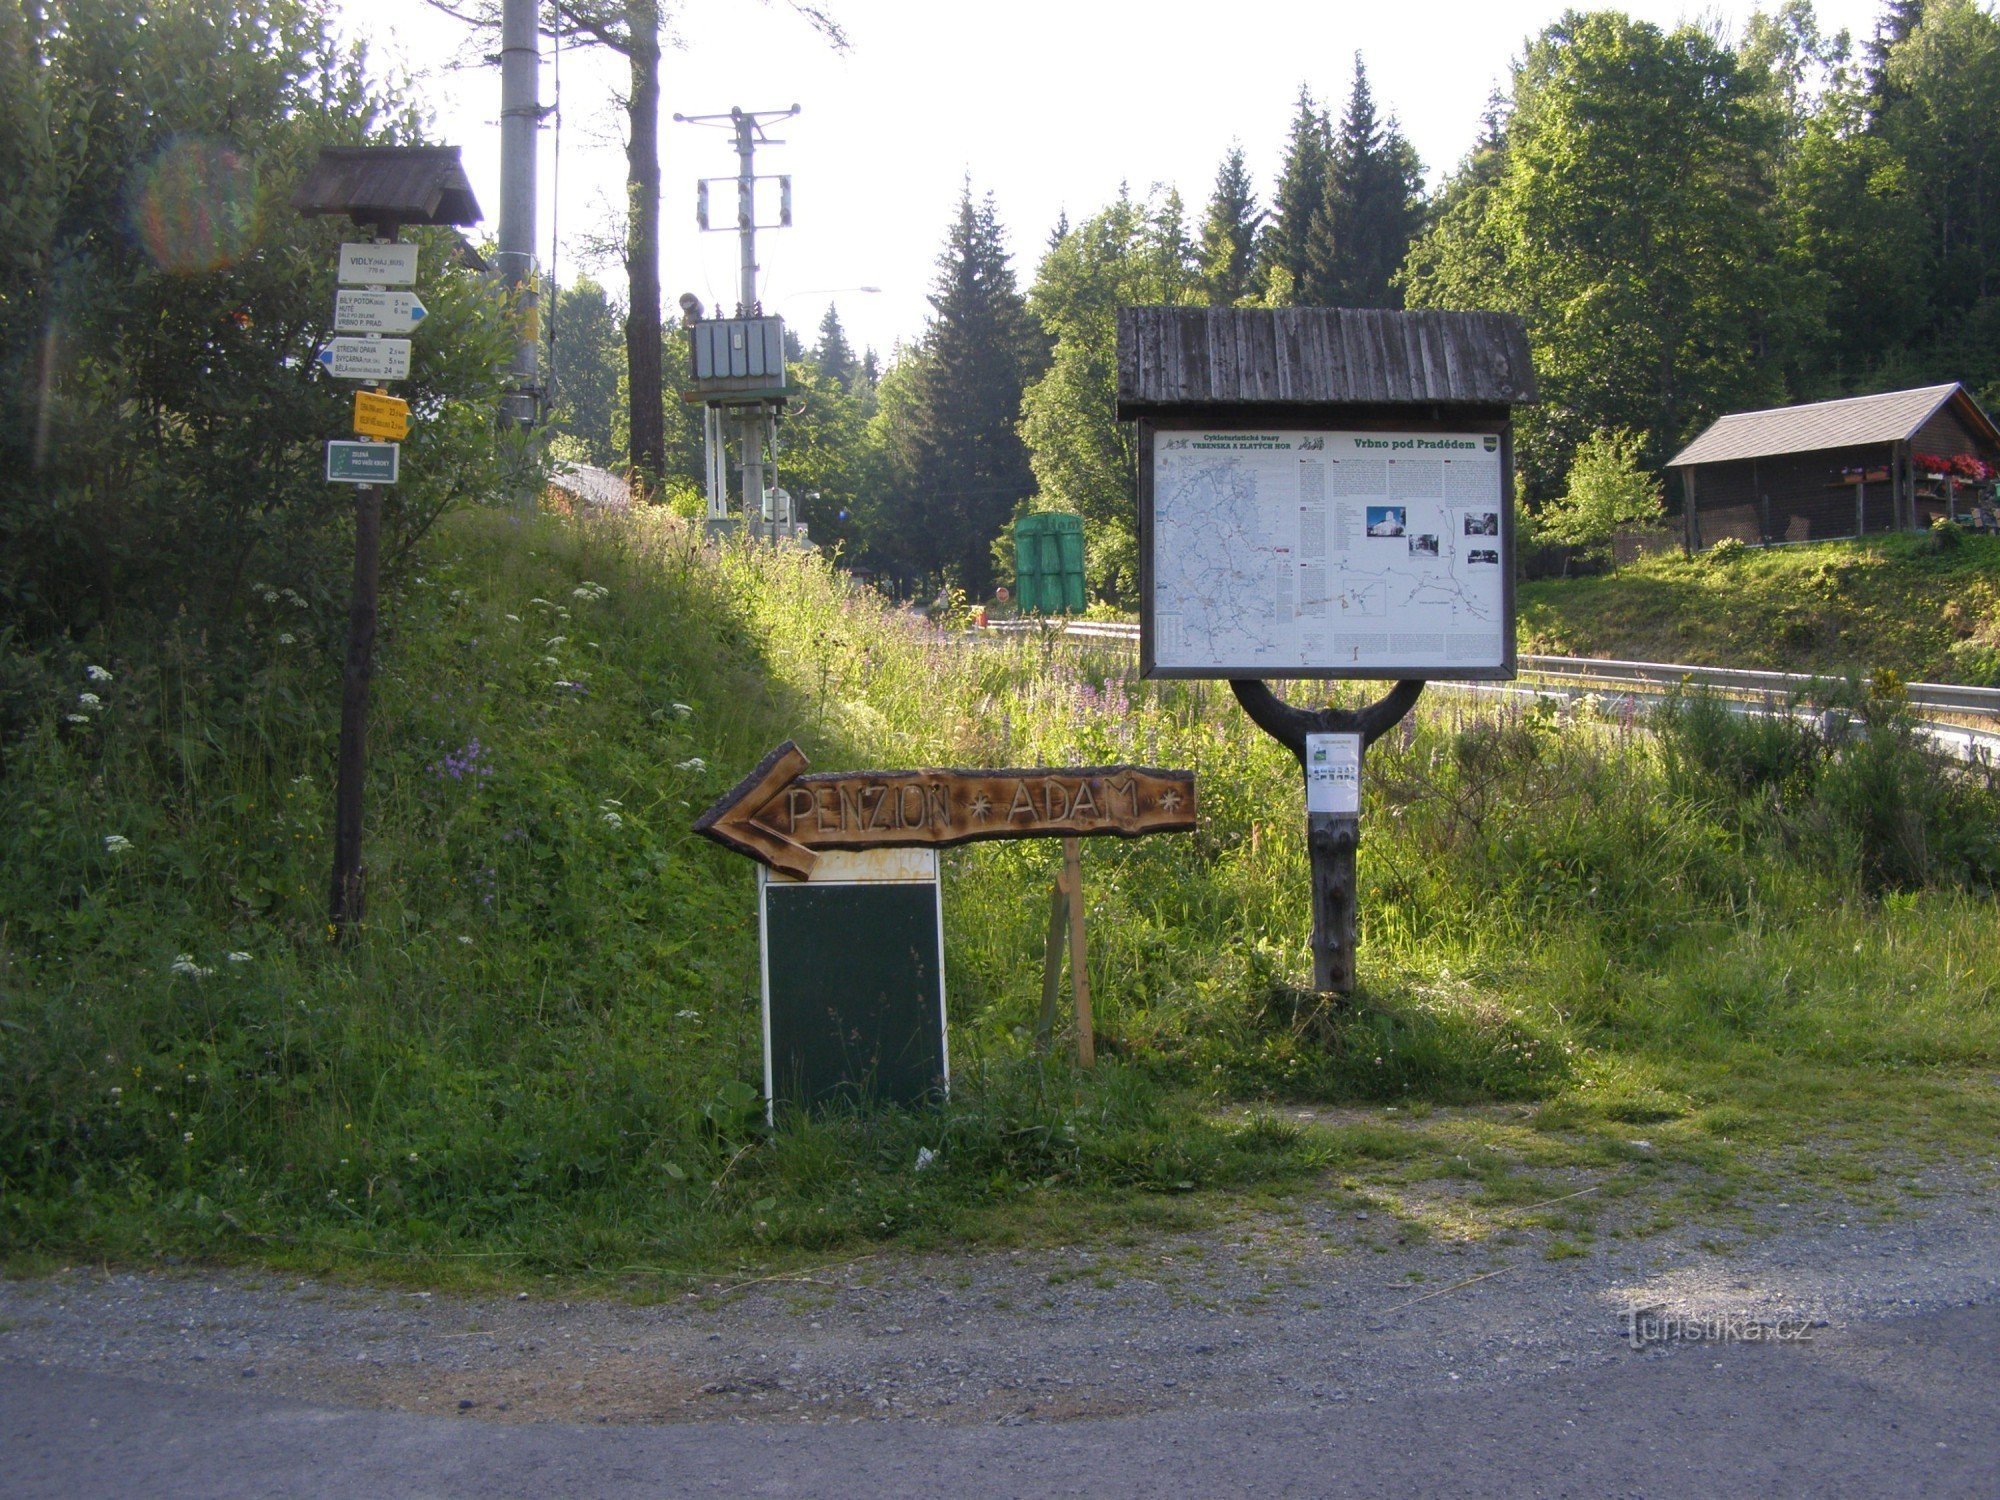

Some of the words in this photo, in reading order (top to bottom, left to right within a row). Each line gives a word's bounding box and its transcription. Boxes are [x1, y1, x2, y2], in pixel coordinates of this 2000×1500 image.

[383, 366, 392, 374] 24
[1203, 434, 1259, 442] Cykloturistické
[1261, 434, 1280, 442] trasy
[1192, 442, 1231, 450] VRBENSKA
[1239, 441, 1273, 450] ZLATÝCH
[1274, 442, 1291, 450] HOR
[1354, 438, 1389, 449] Vrbno
[1392, 438, 1414, 450] pod
[1416, 439, 1476, 450] Pradědem
[786, 781, 951, 833] PENZION
[1006, 776, 1139, 824] ADAM
